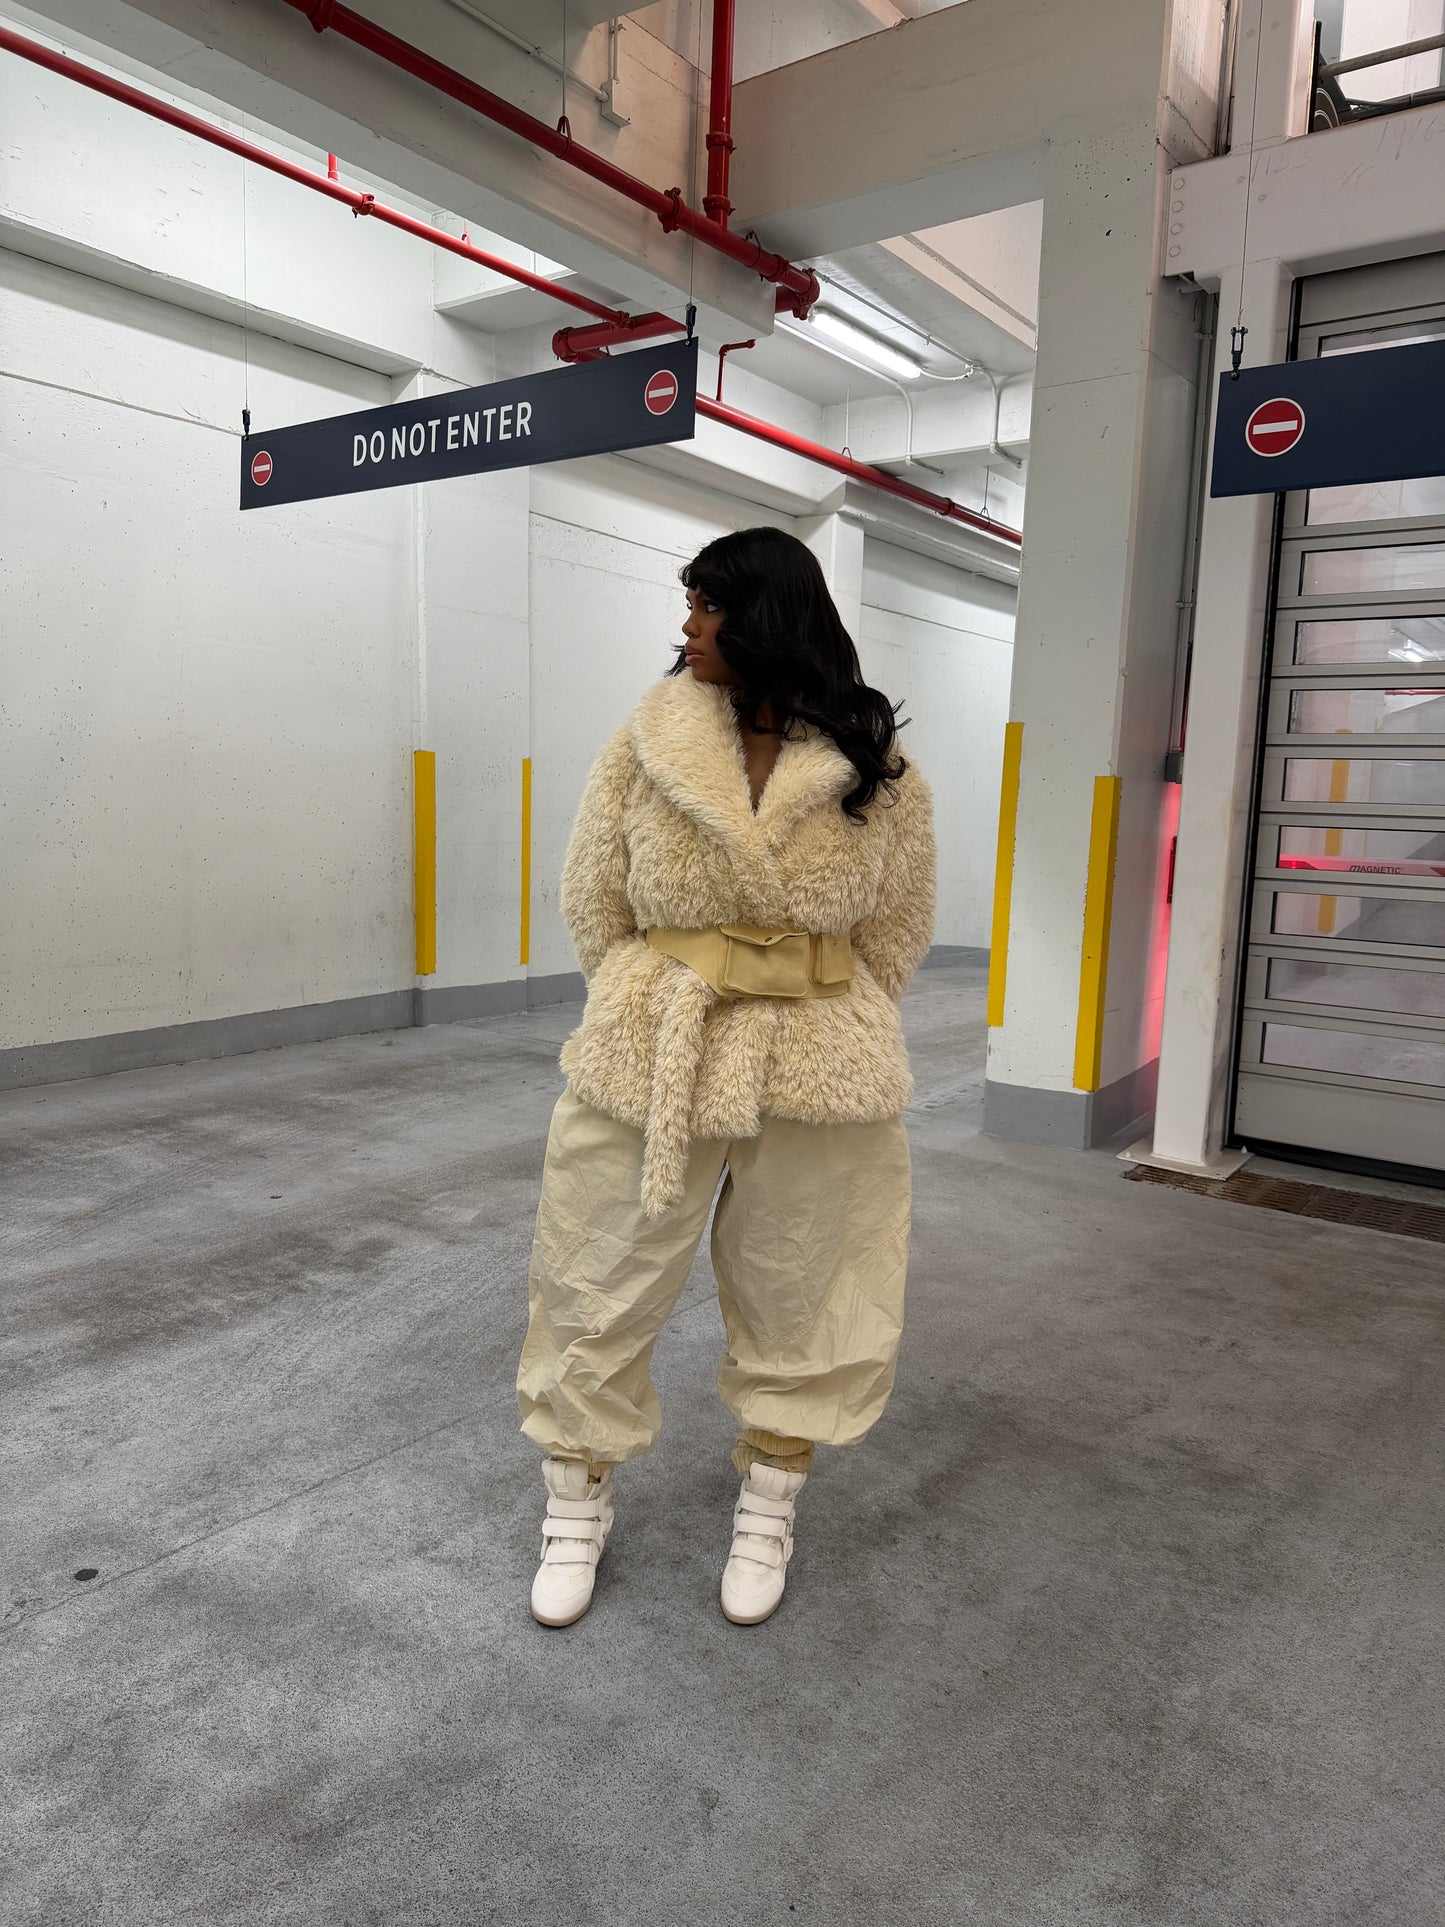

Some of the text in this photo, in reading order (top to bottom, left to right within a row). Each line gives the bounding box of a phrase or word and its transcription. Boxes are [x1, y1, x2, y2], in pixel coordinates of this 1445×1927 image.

[353, 401, 533, 466] DO NOT ENTER
